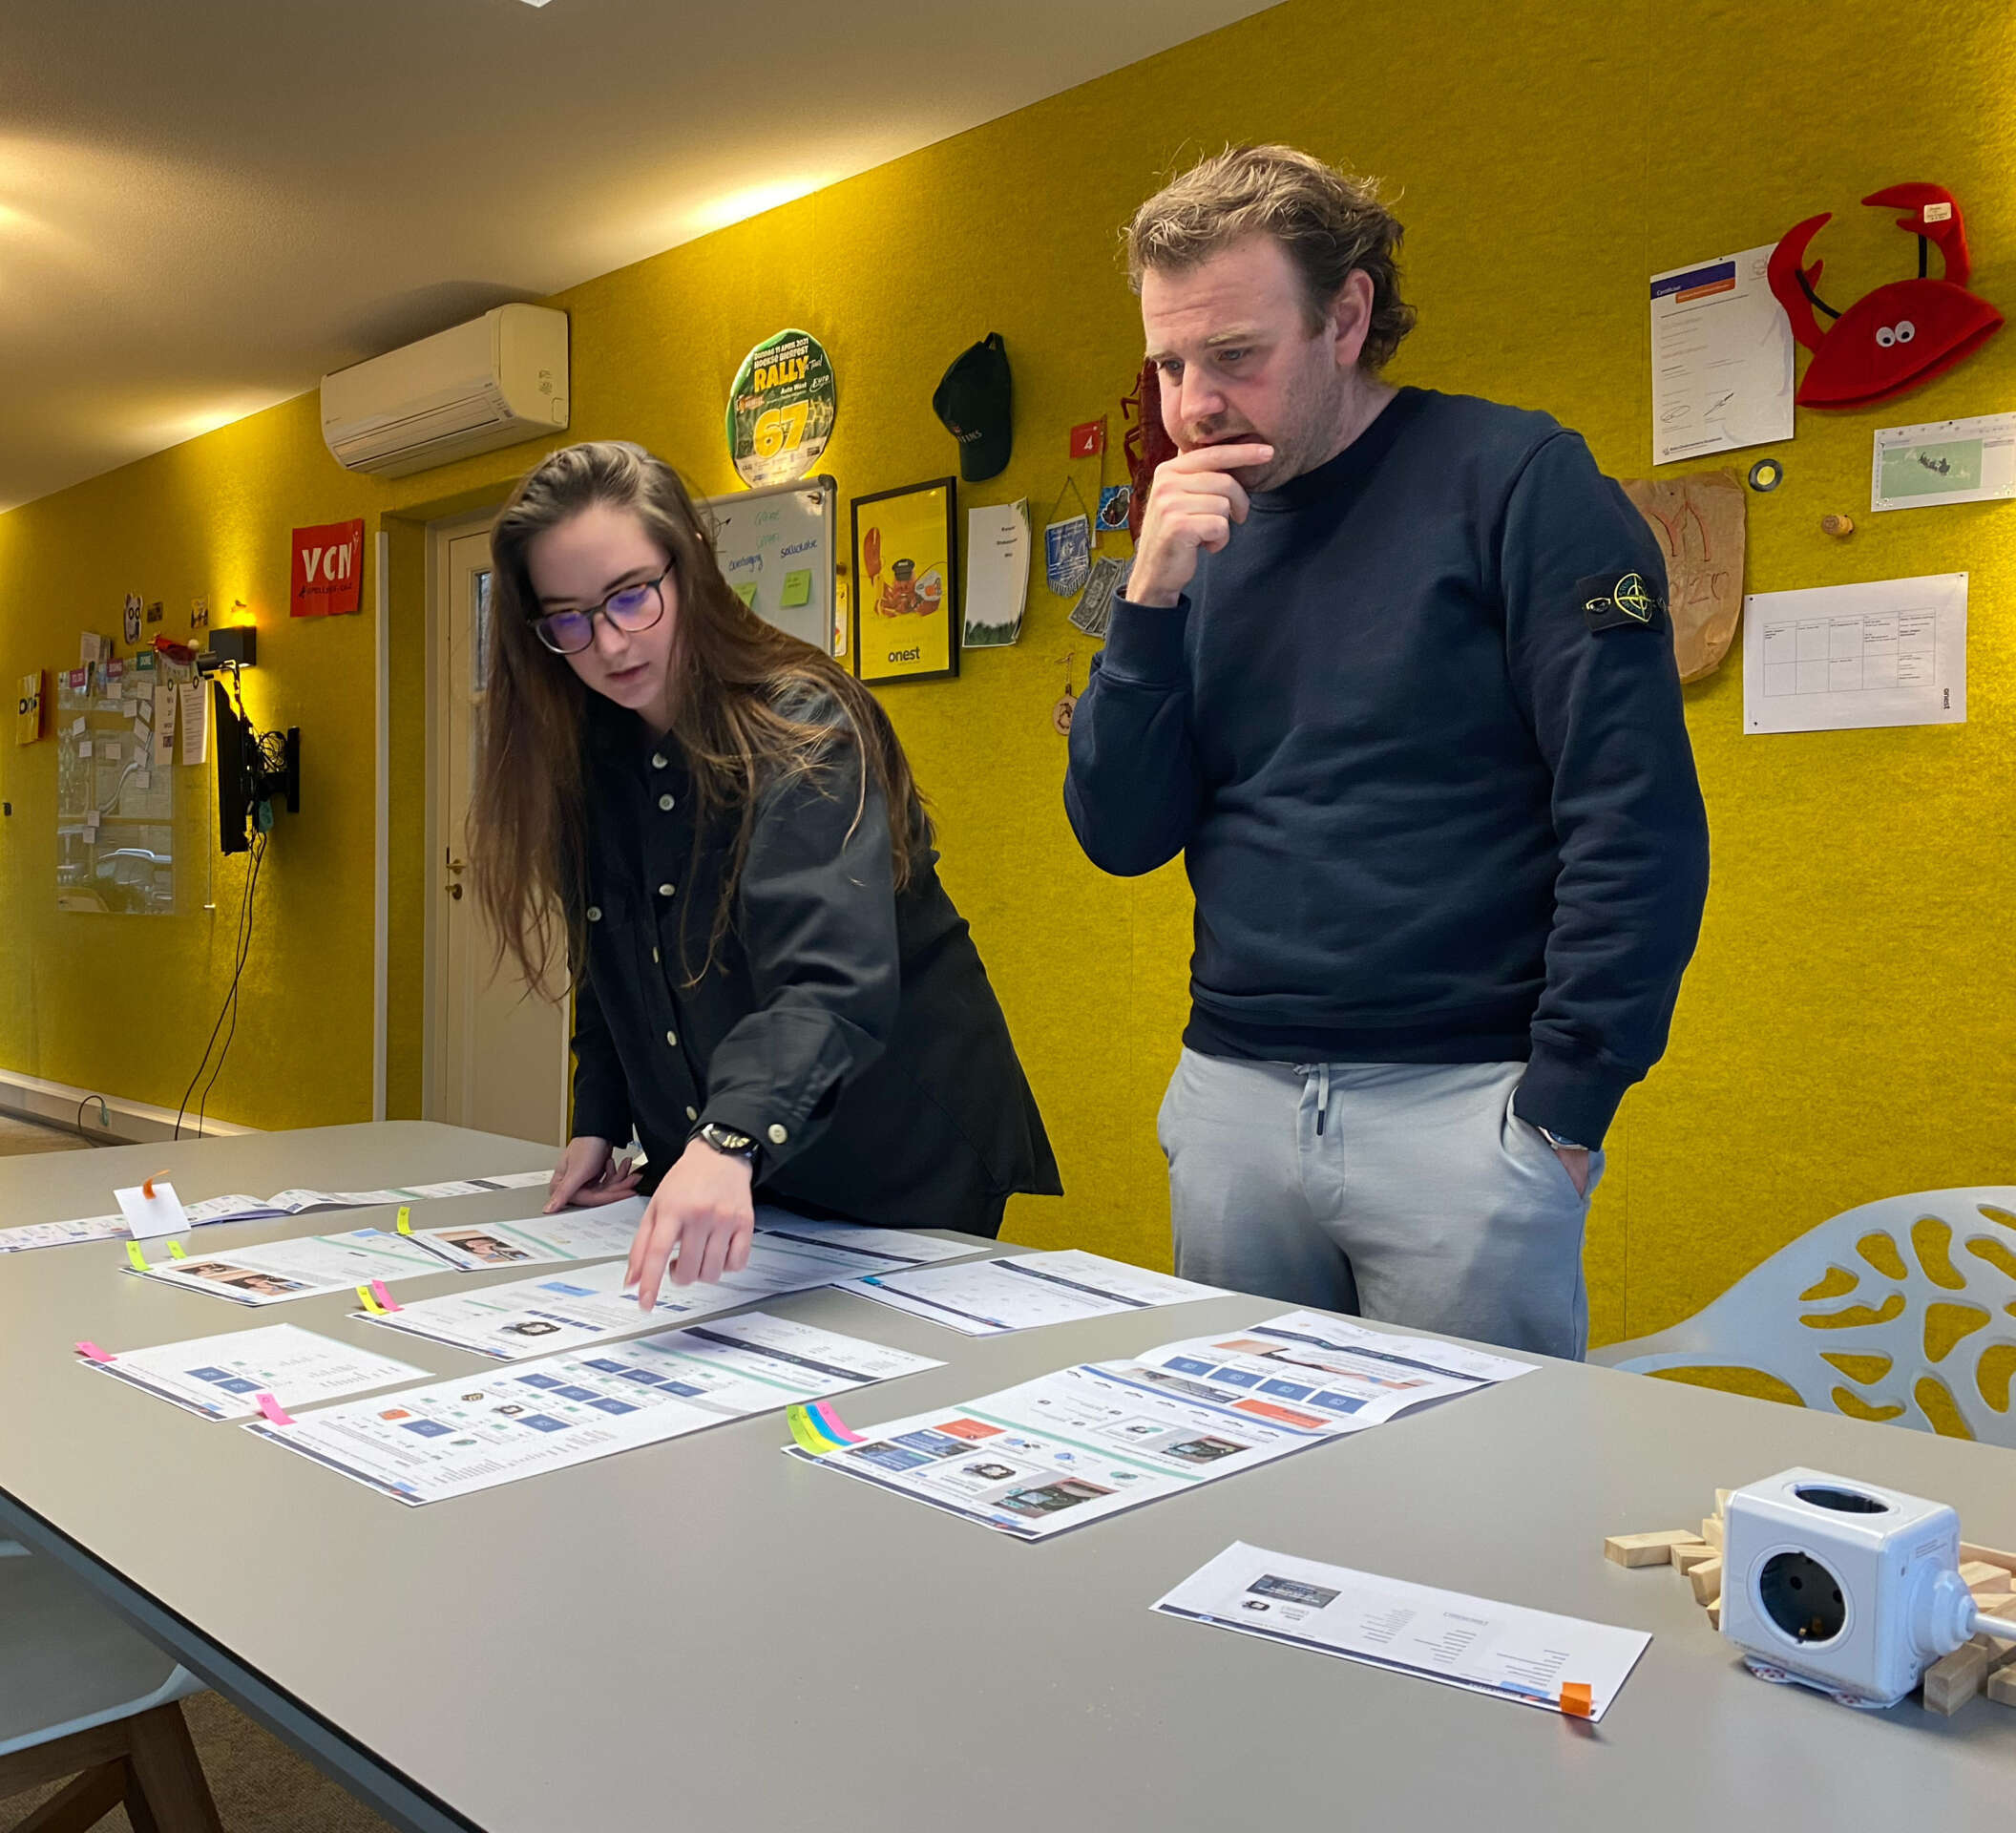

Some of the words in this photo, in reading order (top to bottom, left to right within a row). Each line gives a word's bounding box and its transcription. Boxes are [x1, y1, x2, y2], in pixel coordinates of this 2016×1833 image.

[754, 355, 809, 393] RALLY
[753, 399, 809, 458] 67
[302, 541, 353, 583] VCN
[888, 645, 921, 664] onest
